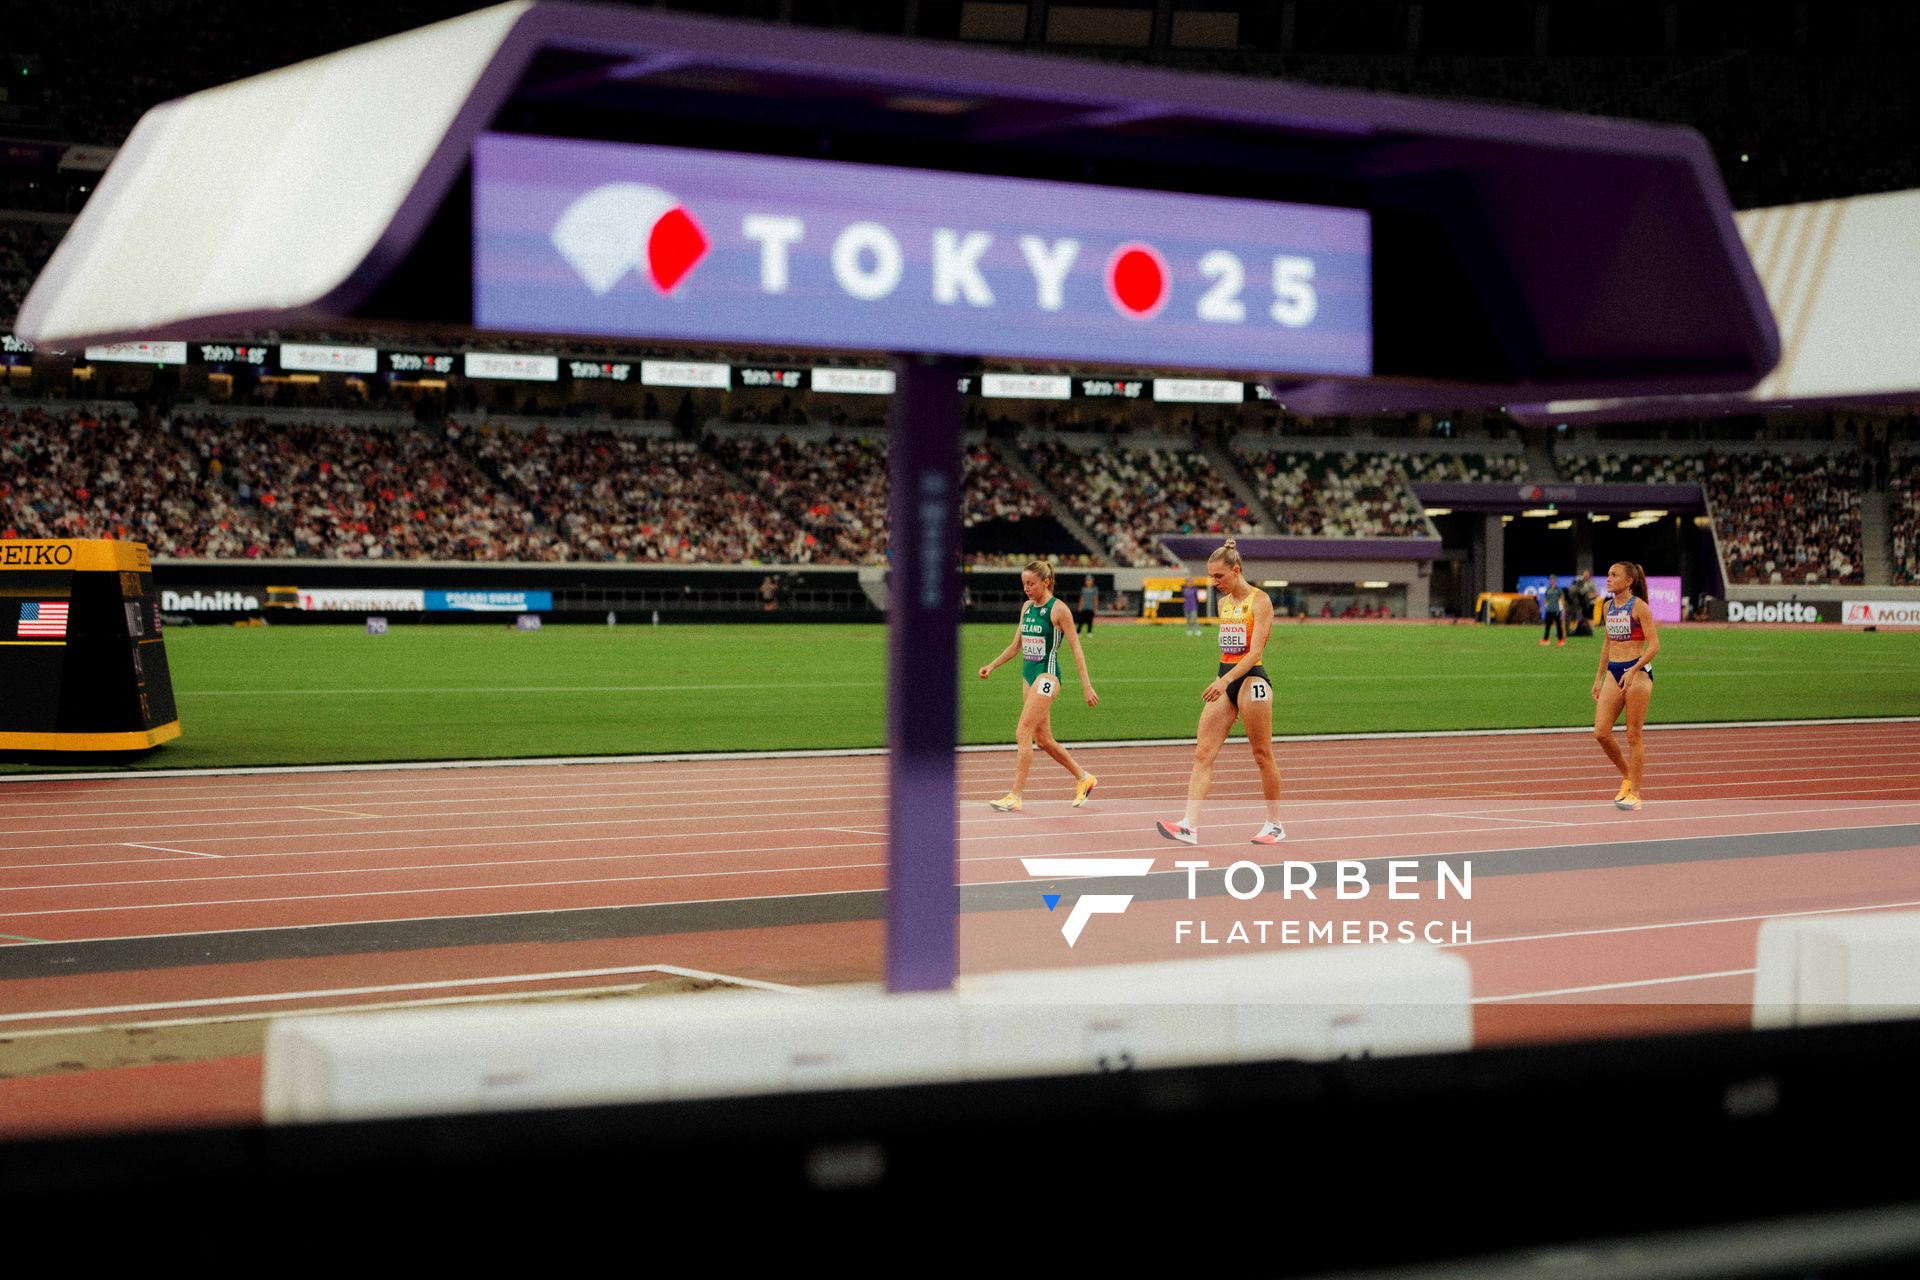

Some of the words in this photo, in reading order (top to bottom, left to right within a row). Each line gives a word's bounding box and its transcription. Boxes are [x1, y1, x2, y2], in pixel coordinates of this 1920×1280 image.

[0, 545, 73, 565] EIKO
[1042, 682, 1051, 694] 8
[1253, 685, 1266, 698] 13
